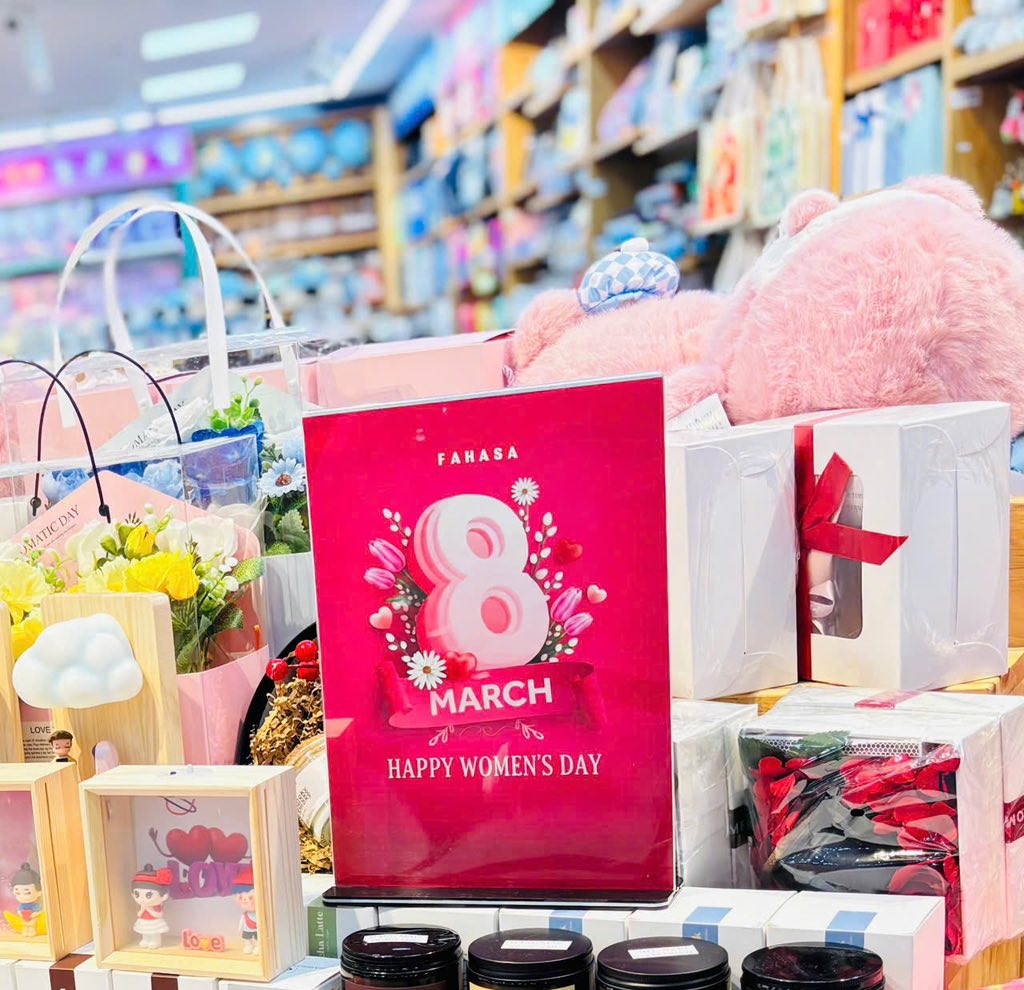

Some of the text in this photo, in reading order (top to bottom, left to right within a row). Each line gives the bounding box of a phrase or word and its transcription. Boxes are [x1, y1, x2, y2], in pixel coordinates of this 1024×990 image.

[437, 445, 519, 467] FAHASA
[58, 504, 80, 527] DAY
[414, 493, 551, 670] 8
[430, 677, 553, 717] MARCH
[29, 726, 51, 734] LOVE
[387, 752, 603, 780] HAPPY WOMEN'S DAY
